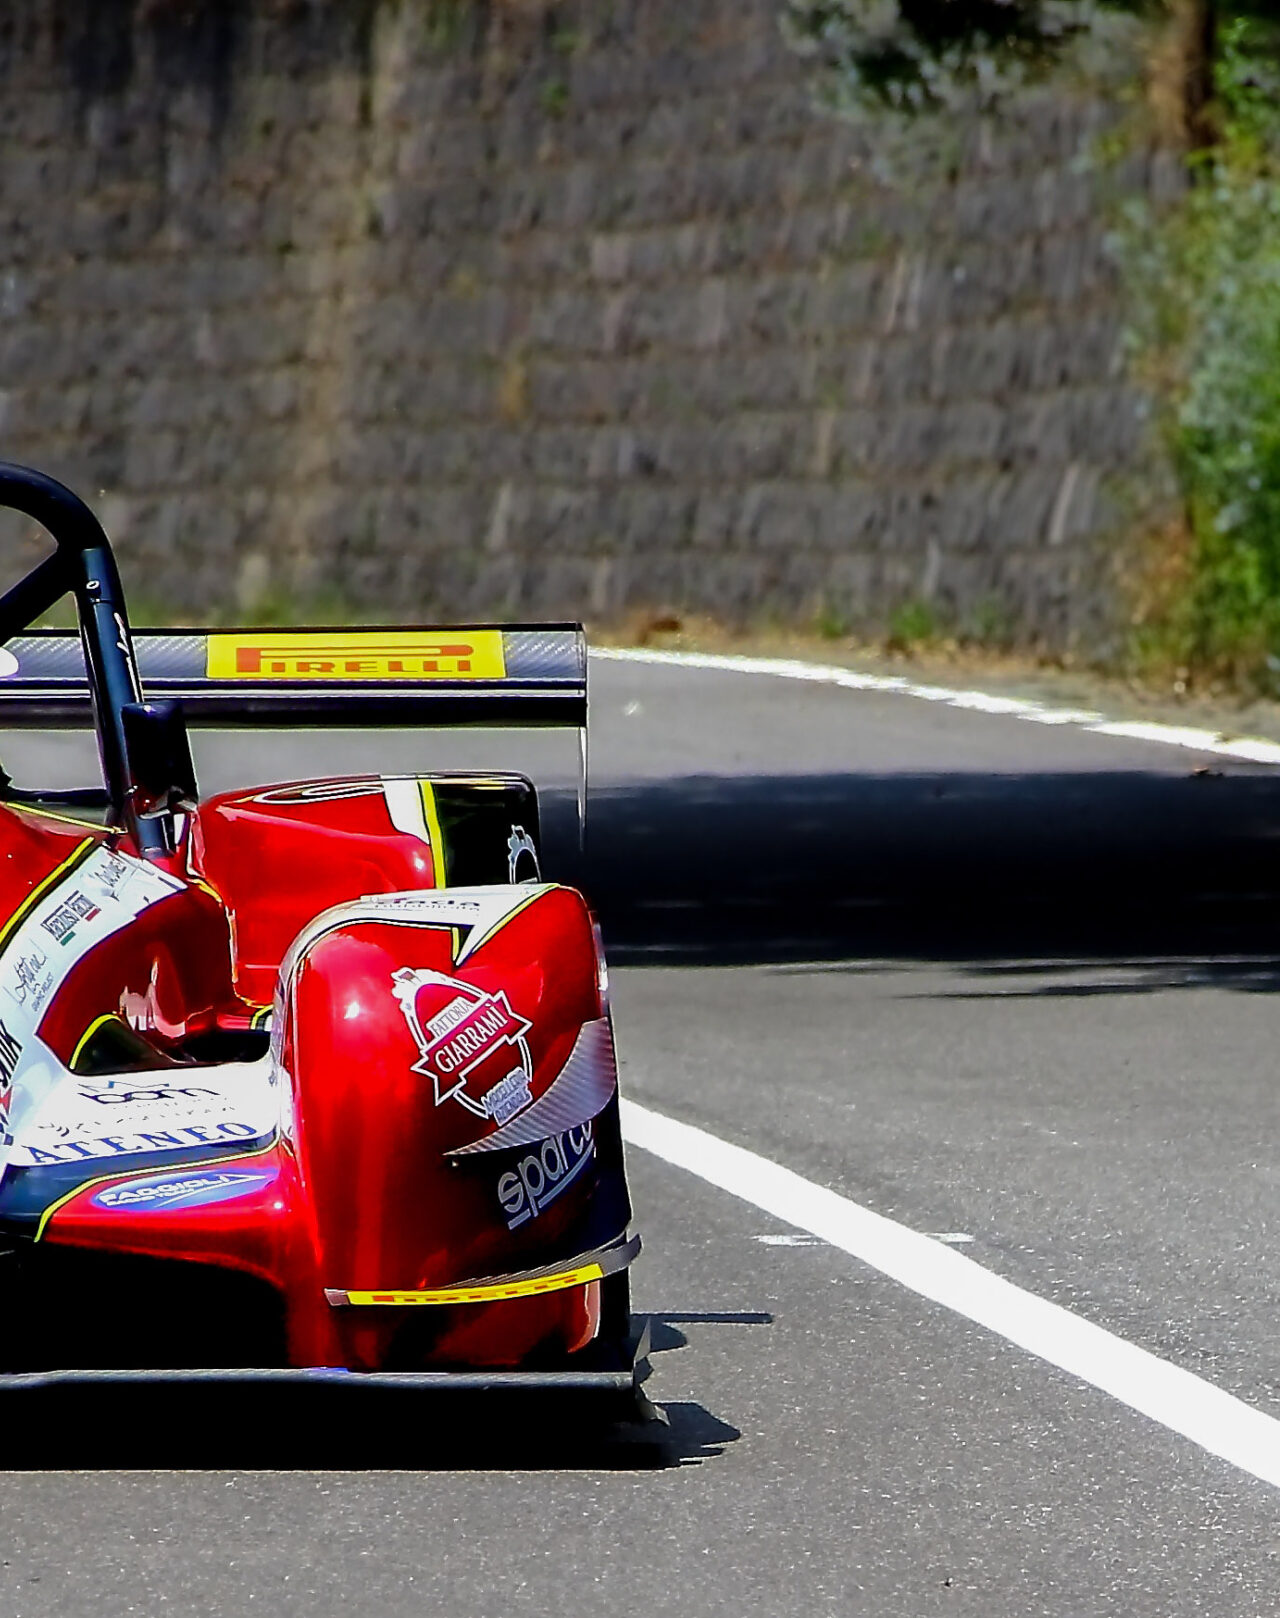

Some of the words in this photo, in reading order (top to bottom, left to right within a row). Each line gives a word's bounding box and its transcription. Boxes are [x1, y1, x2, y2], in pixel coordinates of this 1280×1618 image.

[236, 644, 474, 673] PIRELLI
[430, 998, 475, 1038] FATTORIA
[20, 1122, 259, 1163] ATENEO
